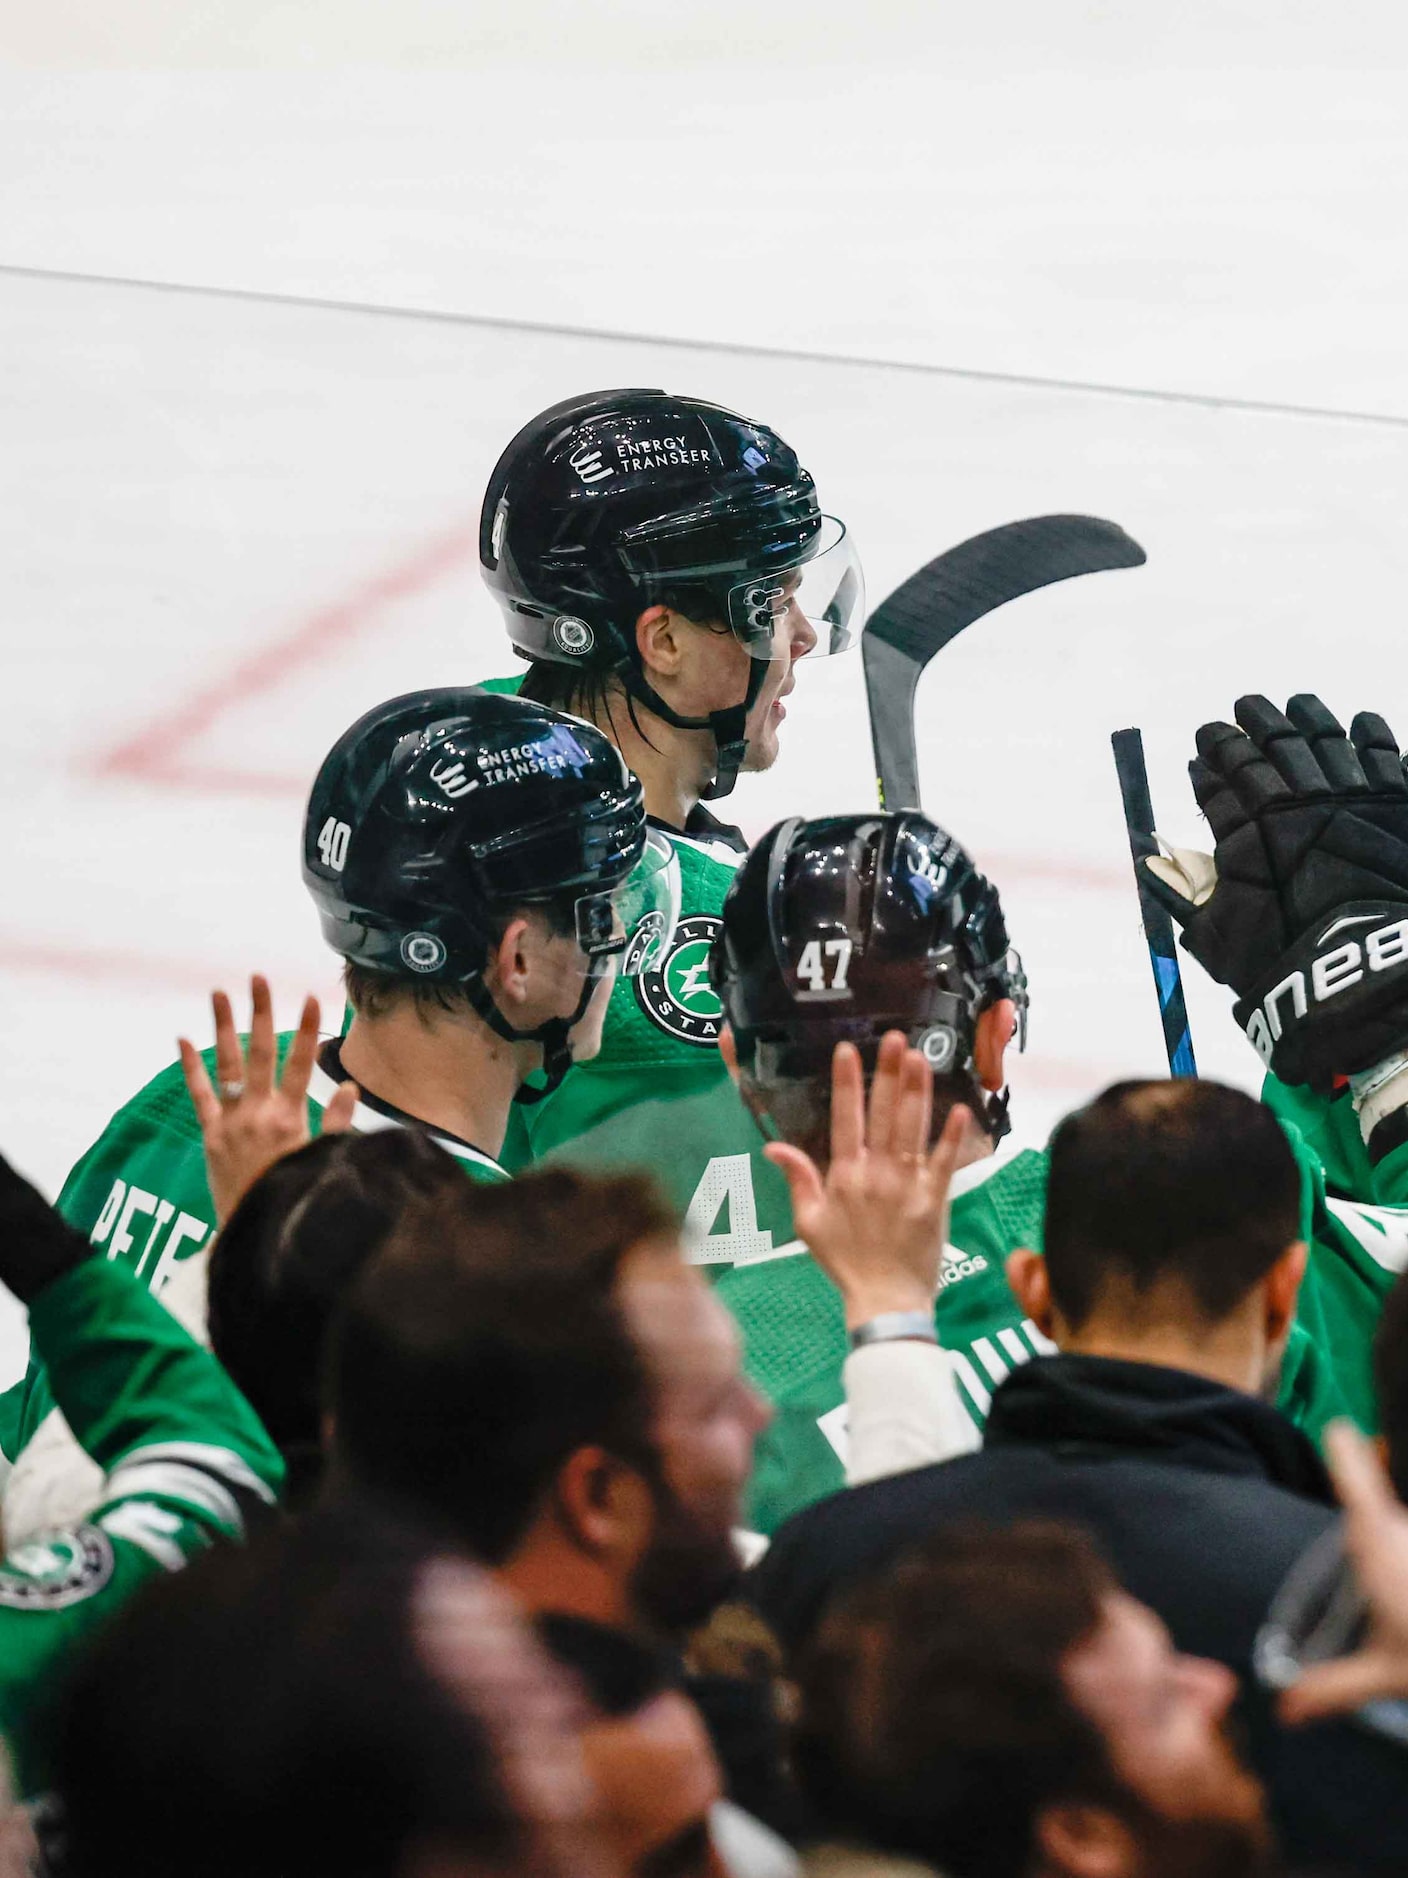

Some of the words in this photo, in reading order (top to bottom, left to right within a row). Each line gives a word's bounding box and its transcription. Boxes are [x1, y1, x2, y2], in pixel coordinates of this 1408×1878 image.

[617, 436, 686, 458] ENERGY
[621, 449, 711, 473] TRANSFER
[476, 742, 543, 770] ENERGY
[483, 755, 567, 787] TRANSFER
[317, 816, 352, 873] 40
[796, 938, 852, 991] 47
[658, 1001, 718, 1034] STA
[90, 1178, 216, 1296] PETE
